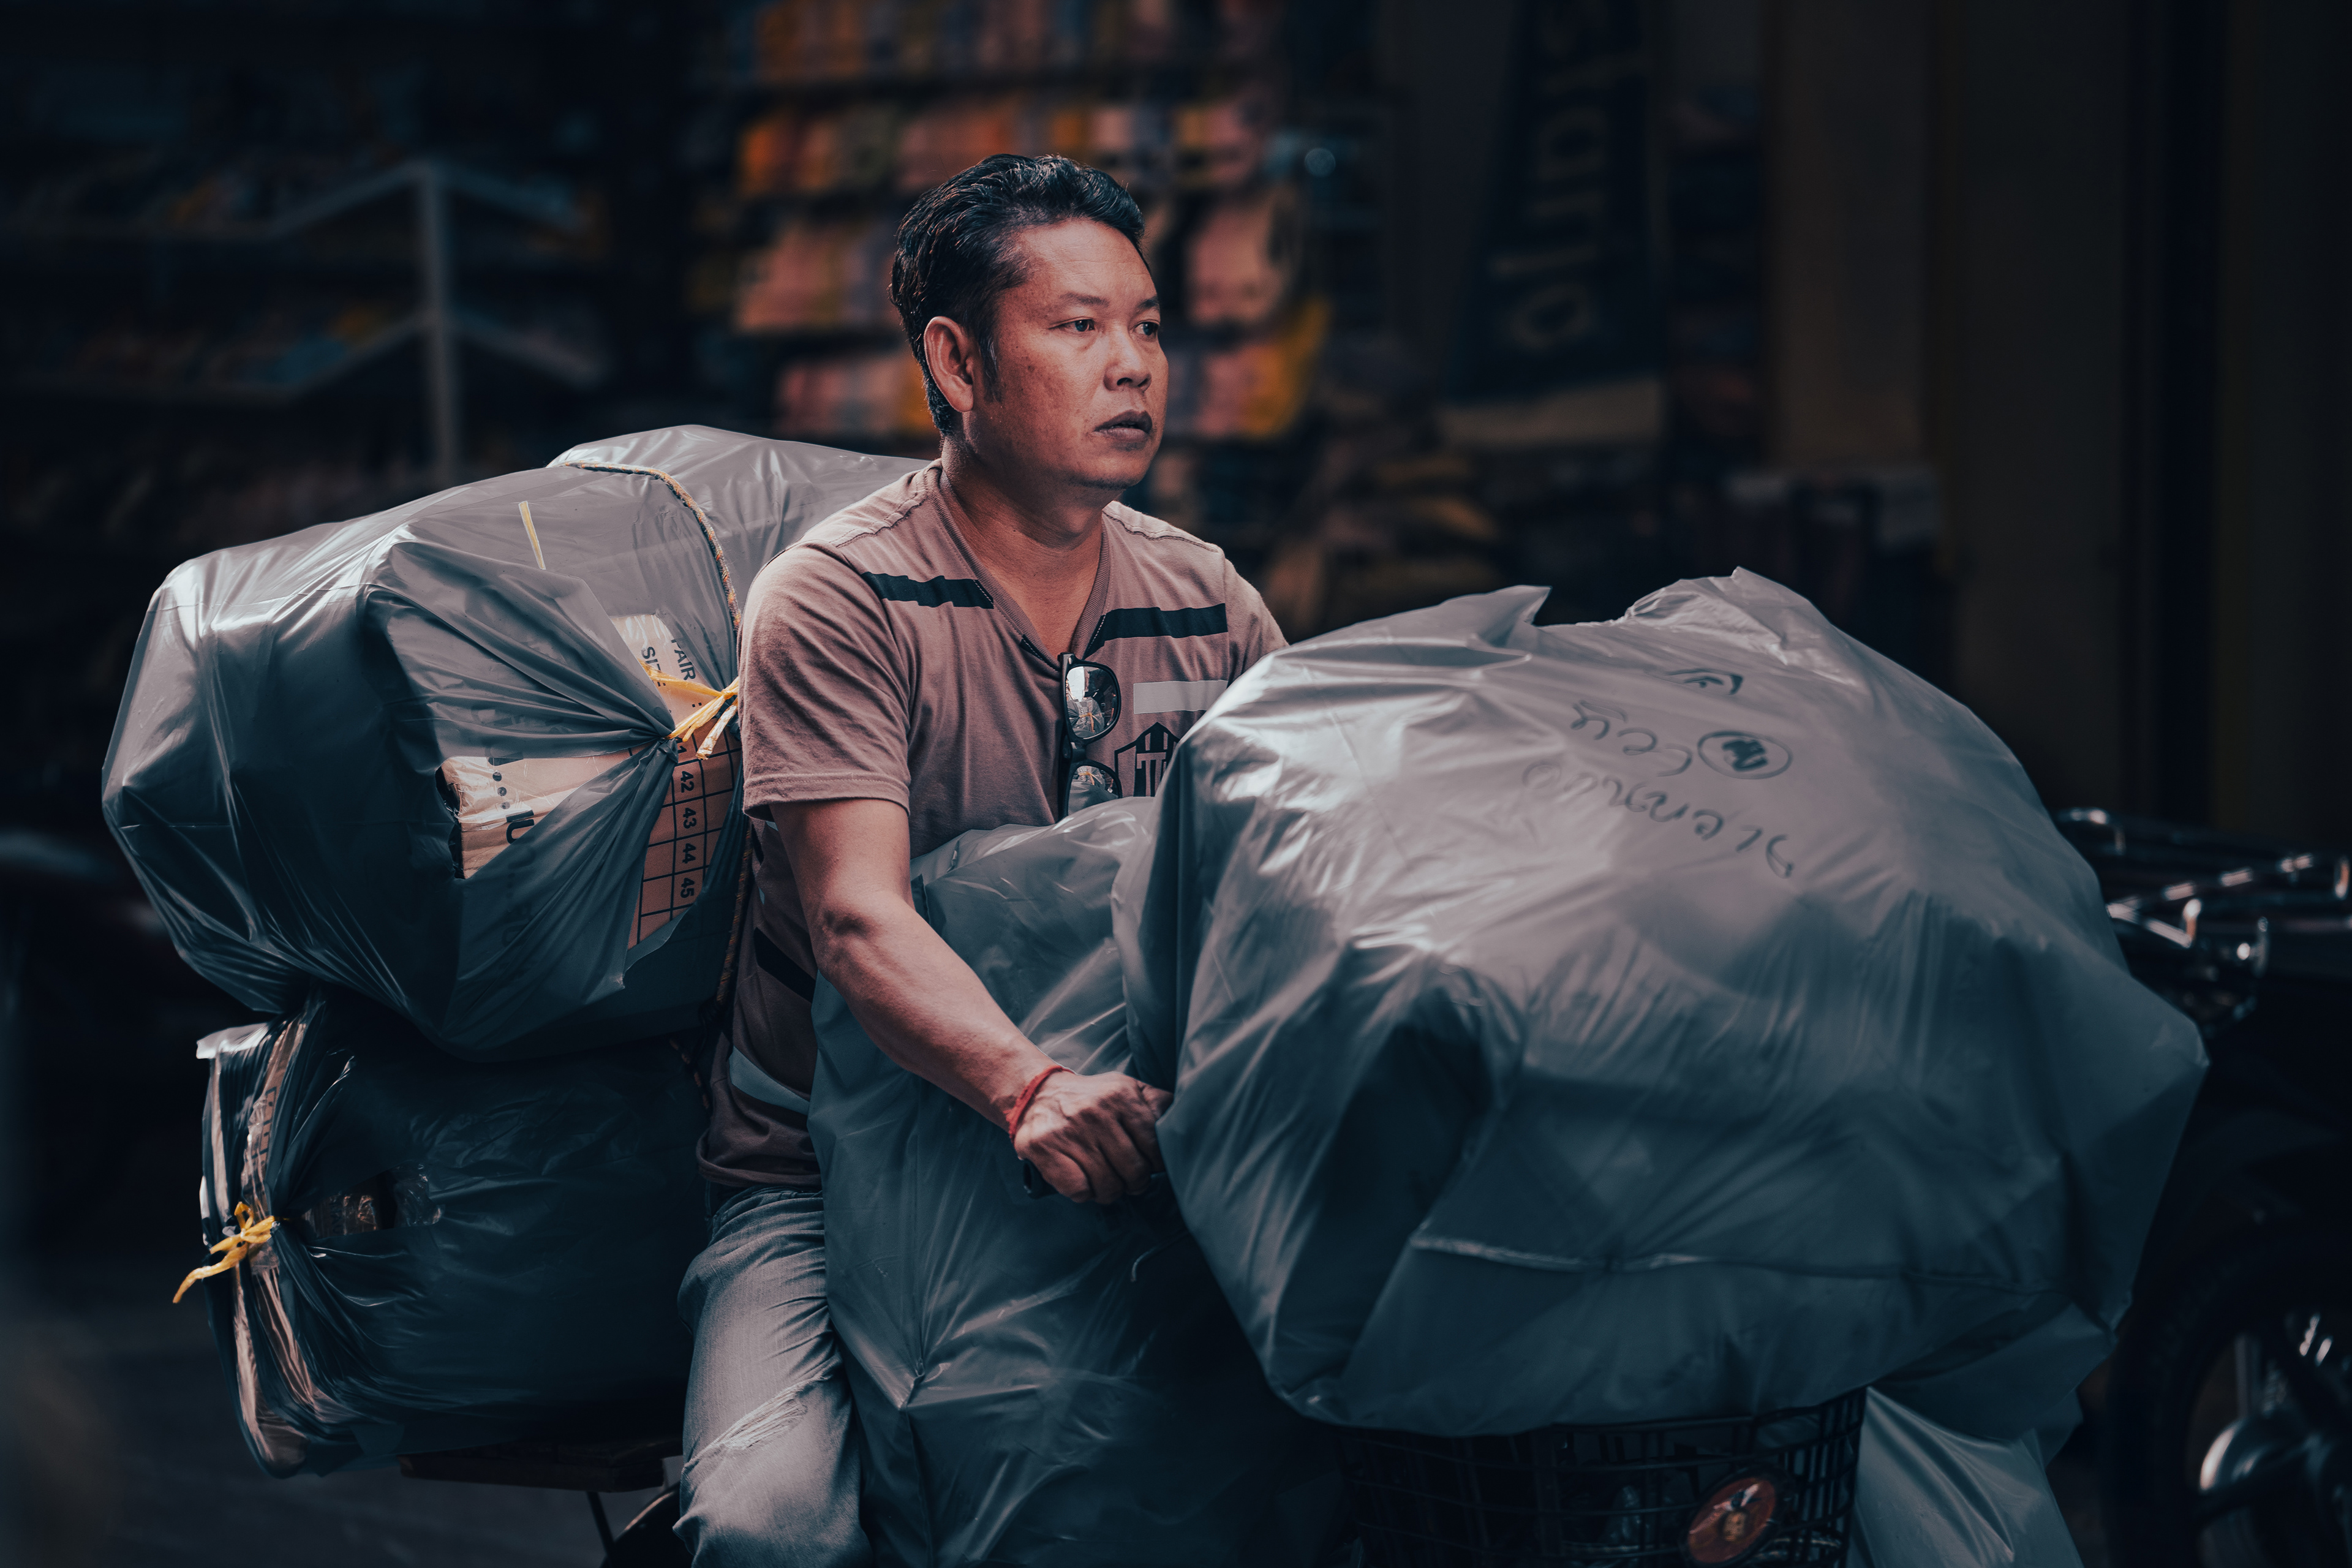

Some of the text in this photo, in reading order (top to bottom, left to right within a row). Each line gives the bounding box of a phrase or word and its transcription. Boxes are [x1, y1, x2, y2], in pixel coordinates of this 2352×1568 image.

[680, 771, 695, 793] 42
[682, 807, 697, 829] 43
[682, 843, 696, 864] 44
[680, 877, 695, 899] 45
